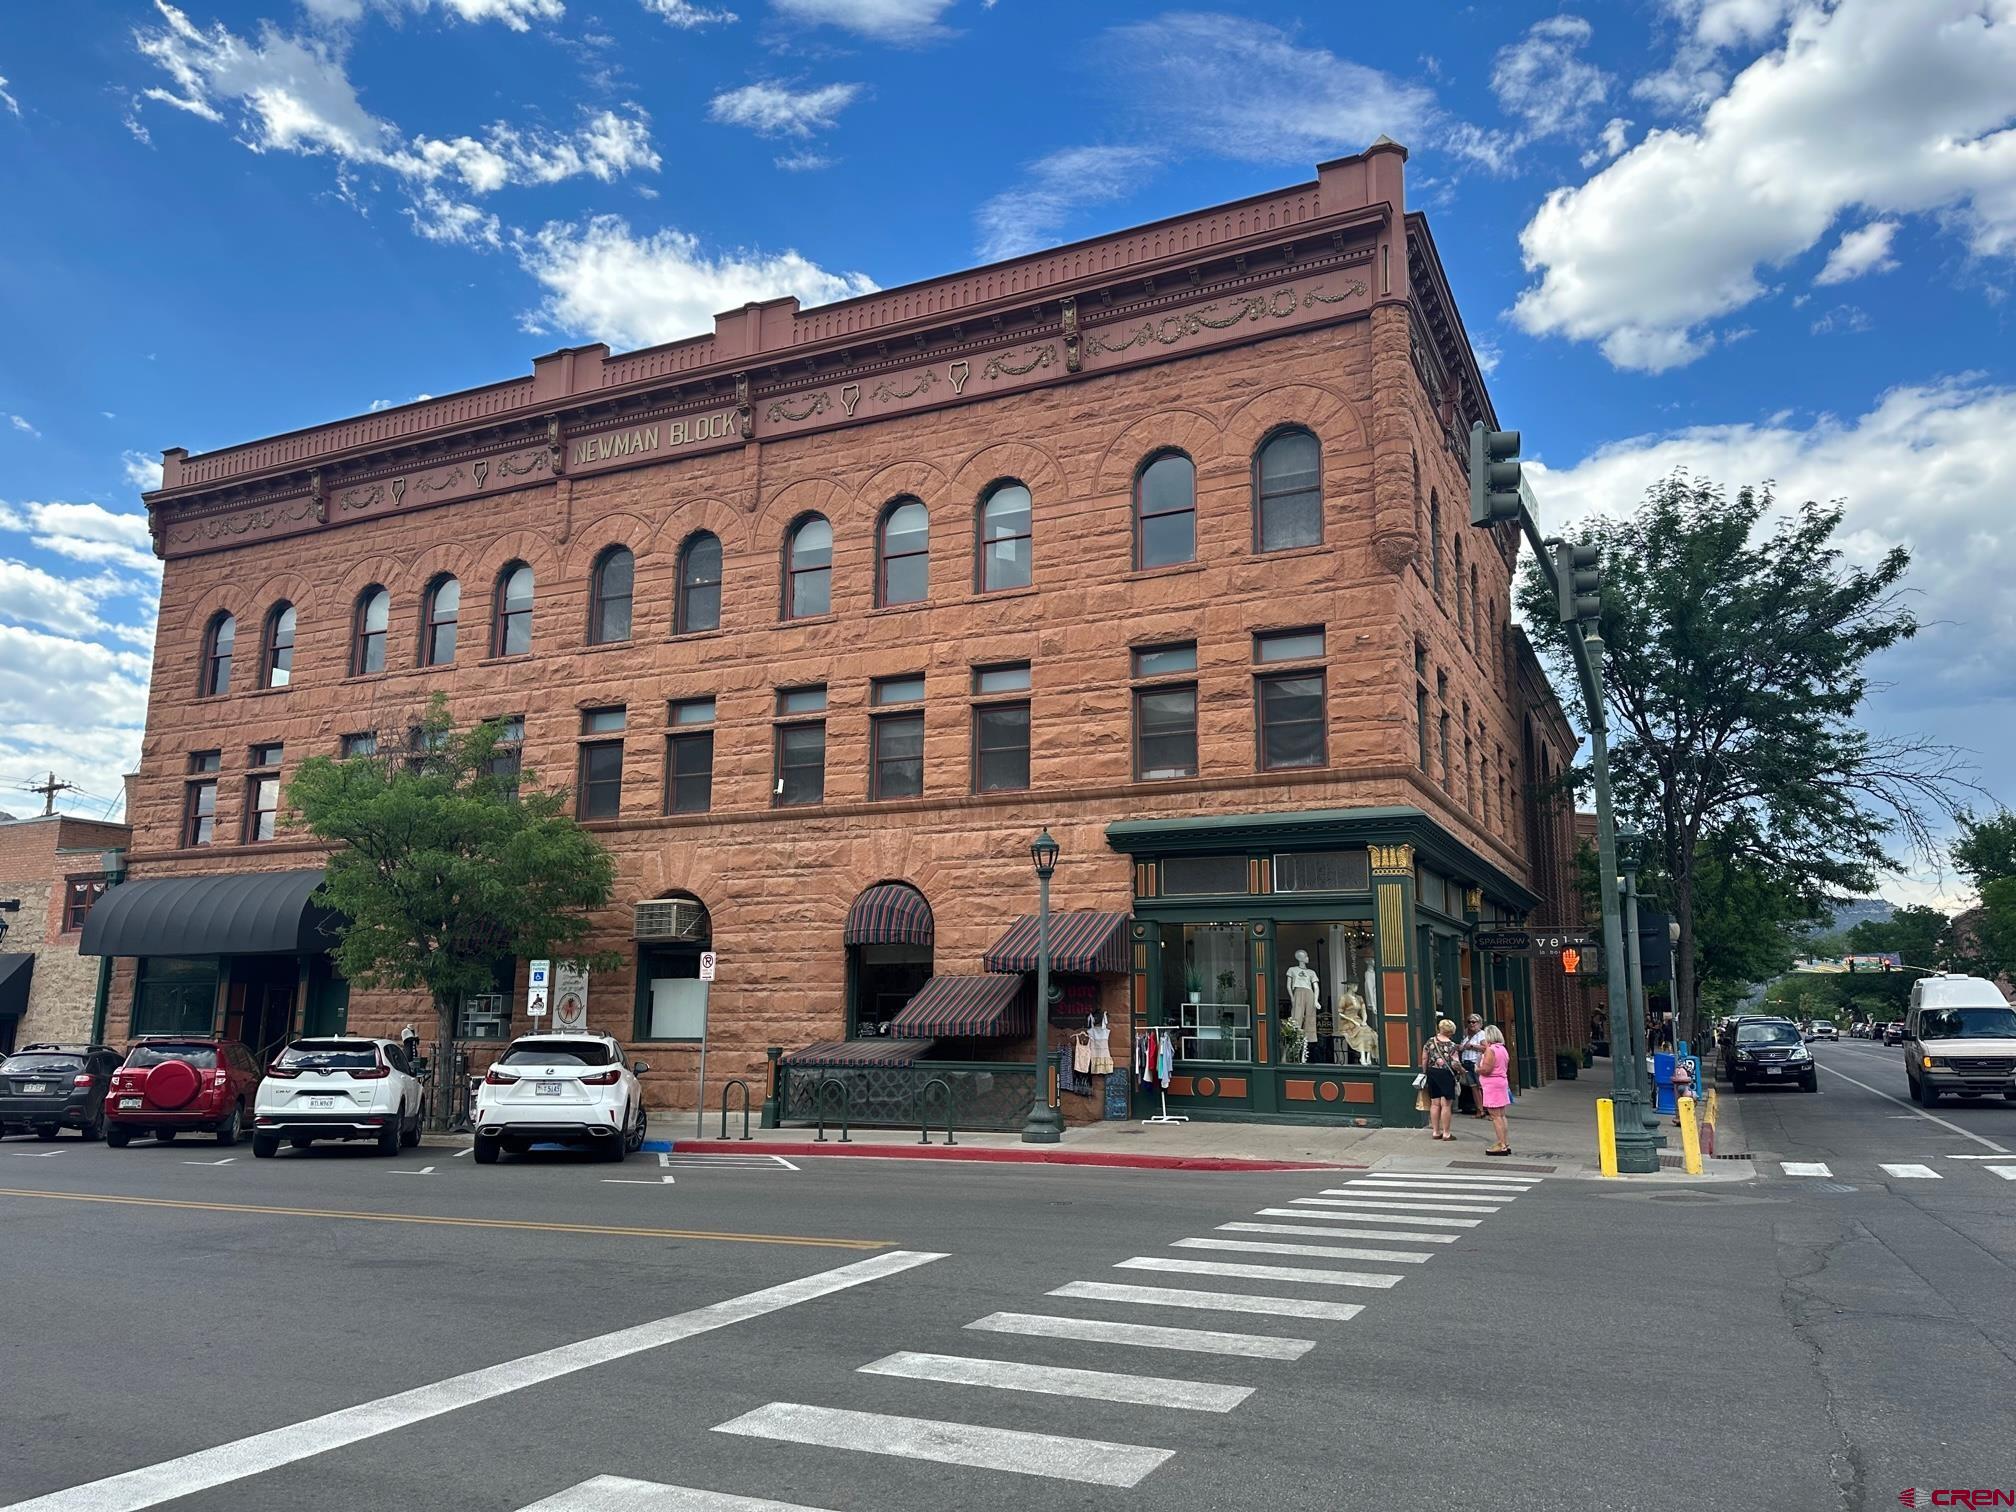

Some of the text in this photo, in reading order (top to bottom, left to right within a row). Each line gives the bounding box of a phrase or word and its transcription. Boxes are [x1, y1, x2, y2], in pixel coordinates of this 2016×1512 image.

[574, 411, 738, 465] NEWMAN BLOCK
[1479, 937, 1526, 945] SPARROW
